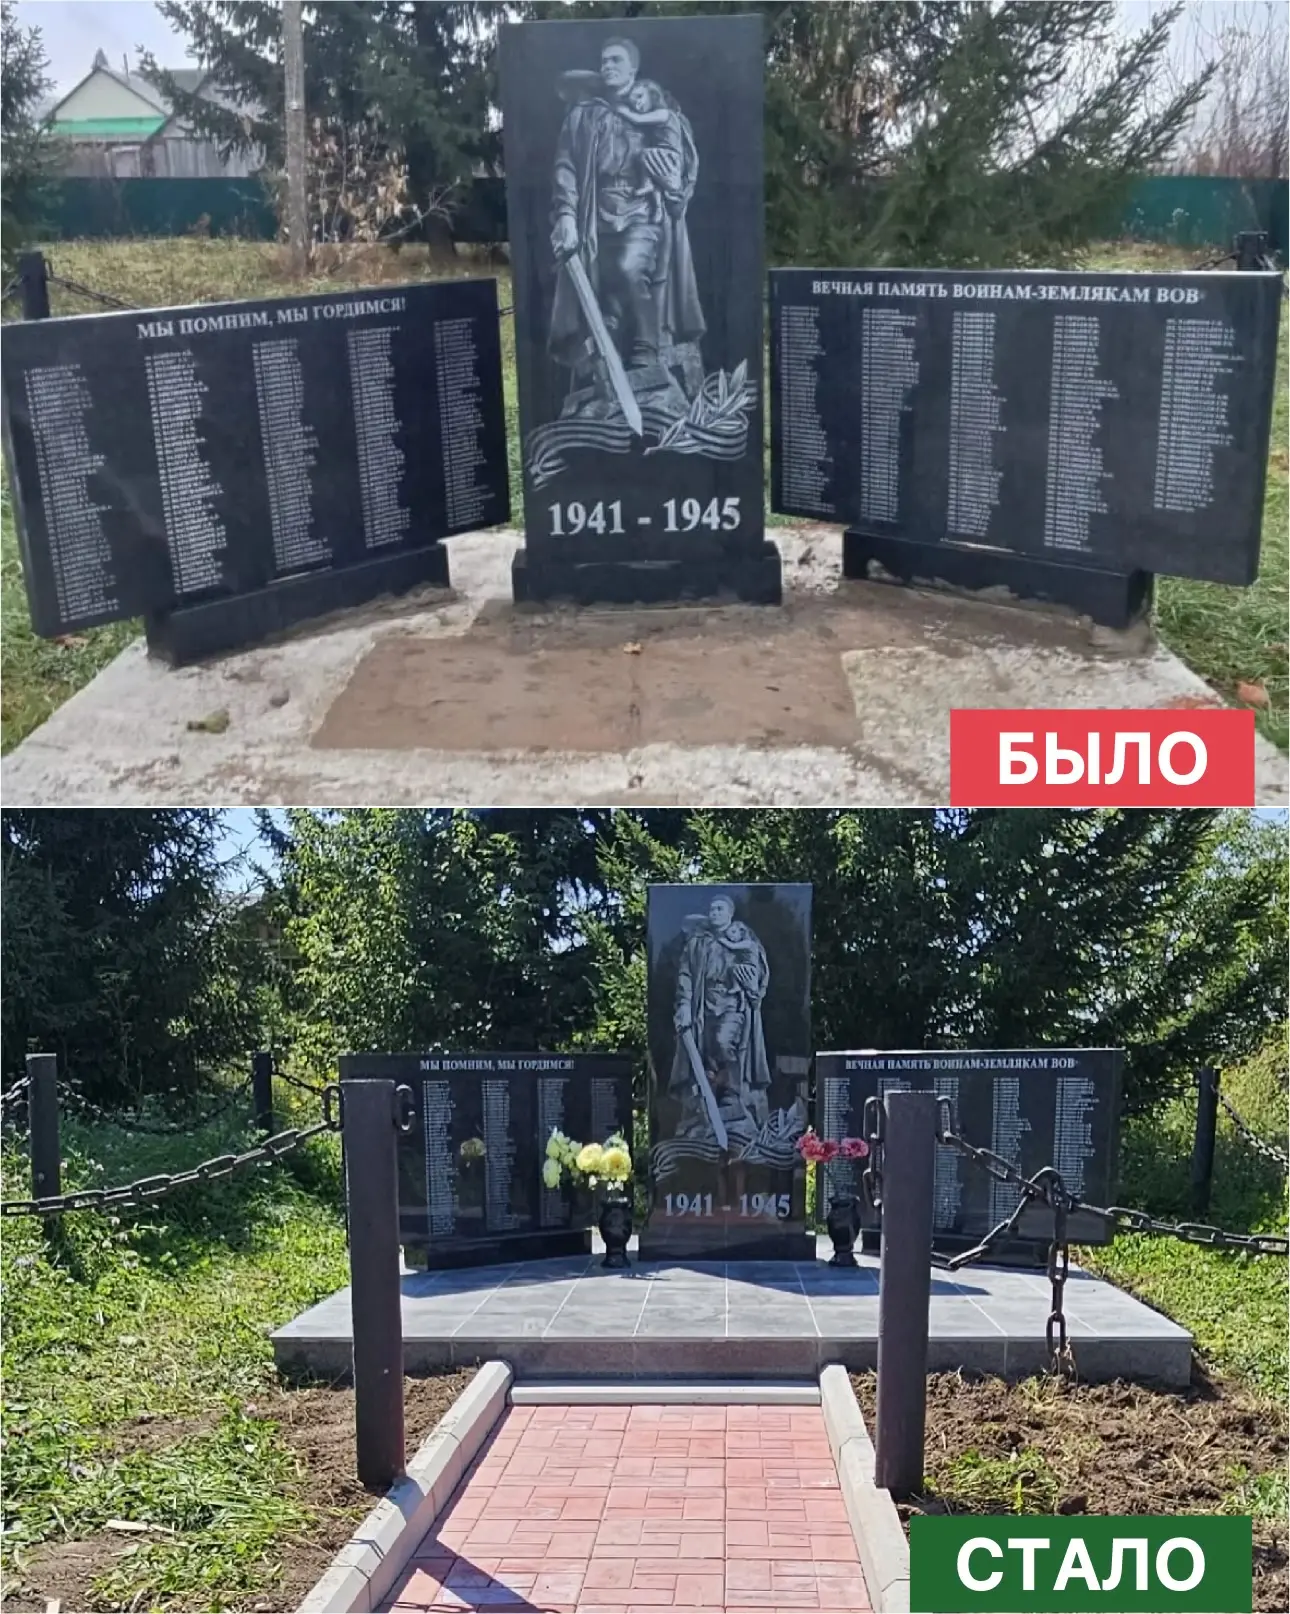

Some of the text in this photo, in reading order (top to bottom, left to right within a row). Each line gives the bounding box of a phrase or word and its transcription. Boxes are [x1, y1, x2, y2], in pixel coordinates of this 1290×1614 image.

[812, 280, 873, 295] ВЕЧНАЯ
[879, 281, 947, 298] ПАМЯТЬ
[953, 283, 1149, 303] ВОИНАМ-ЗЕМЛЯКАМ
[136, 297, 407, 339] МЫ ПОМНИМ, МЫ ГОРДИМСЯ!
[548, 497, 741, 536] 1941 - 1945
[420, 1060, 440, 1070] МЫ
[498, 1060, 515, 1070] МЫ
[518, 1060, 575, 1071] ГОРДИМСЯ!
[845, 1059, 885, 1070] ВЕЧНАЯ
[887, 1059, 931, 1070] ПАМЯТЬ
[664, 1192, 713, 1217] 1941
[740, 1192, 790, 1218] 1945
